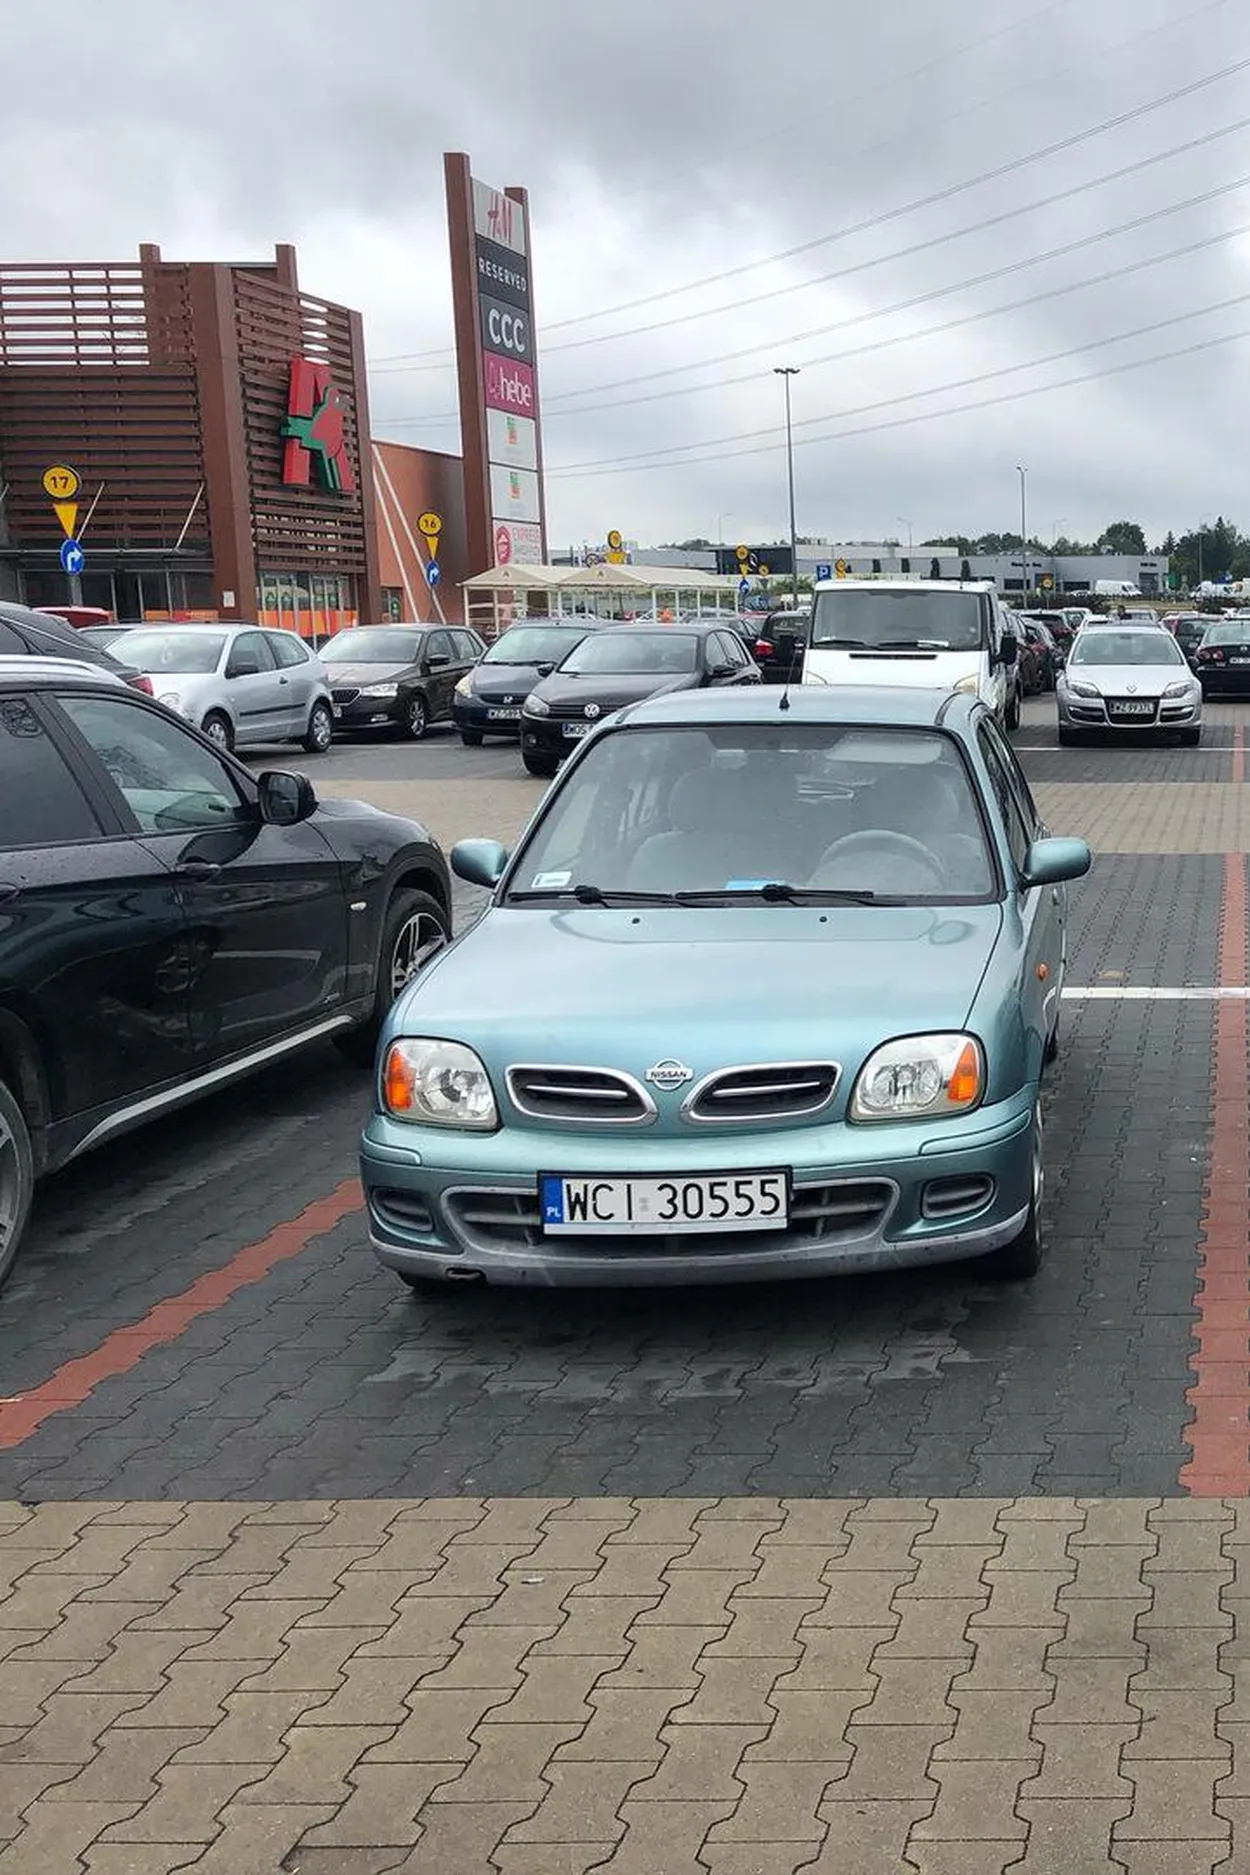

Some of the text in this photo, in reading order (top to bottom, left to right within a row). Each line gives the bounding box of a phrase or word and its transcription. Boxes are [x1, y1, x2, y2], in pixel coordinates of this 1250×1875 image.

[478, 256, 527, 292] RESERVED
[488, 308, 526, 353] CCC
[500, 366, 533, 408] hebe
[51, 475, 69, 489] 17
[546, 1178, 781, 1221] PL WCI 30555
